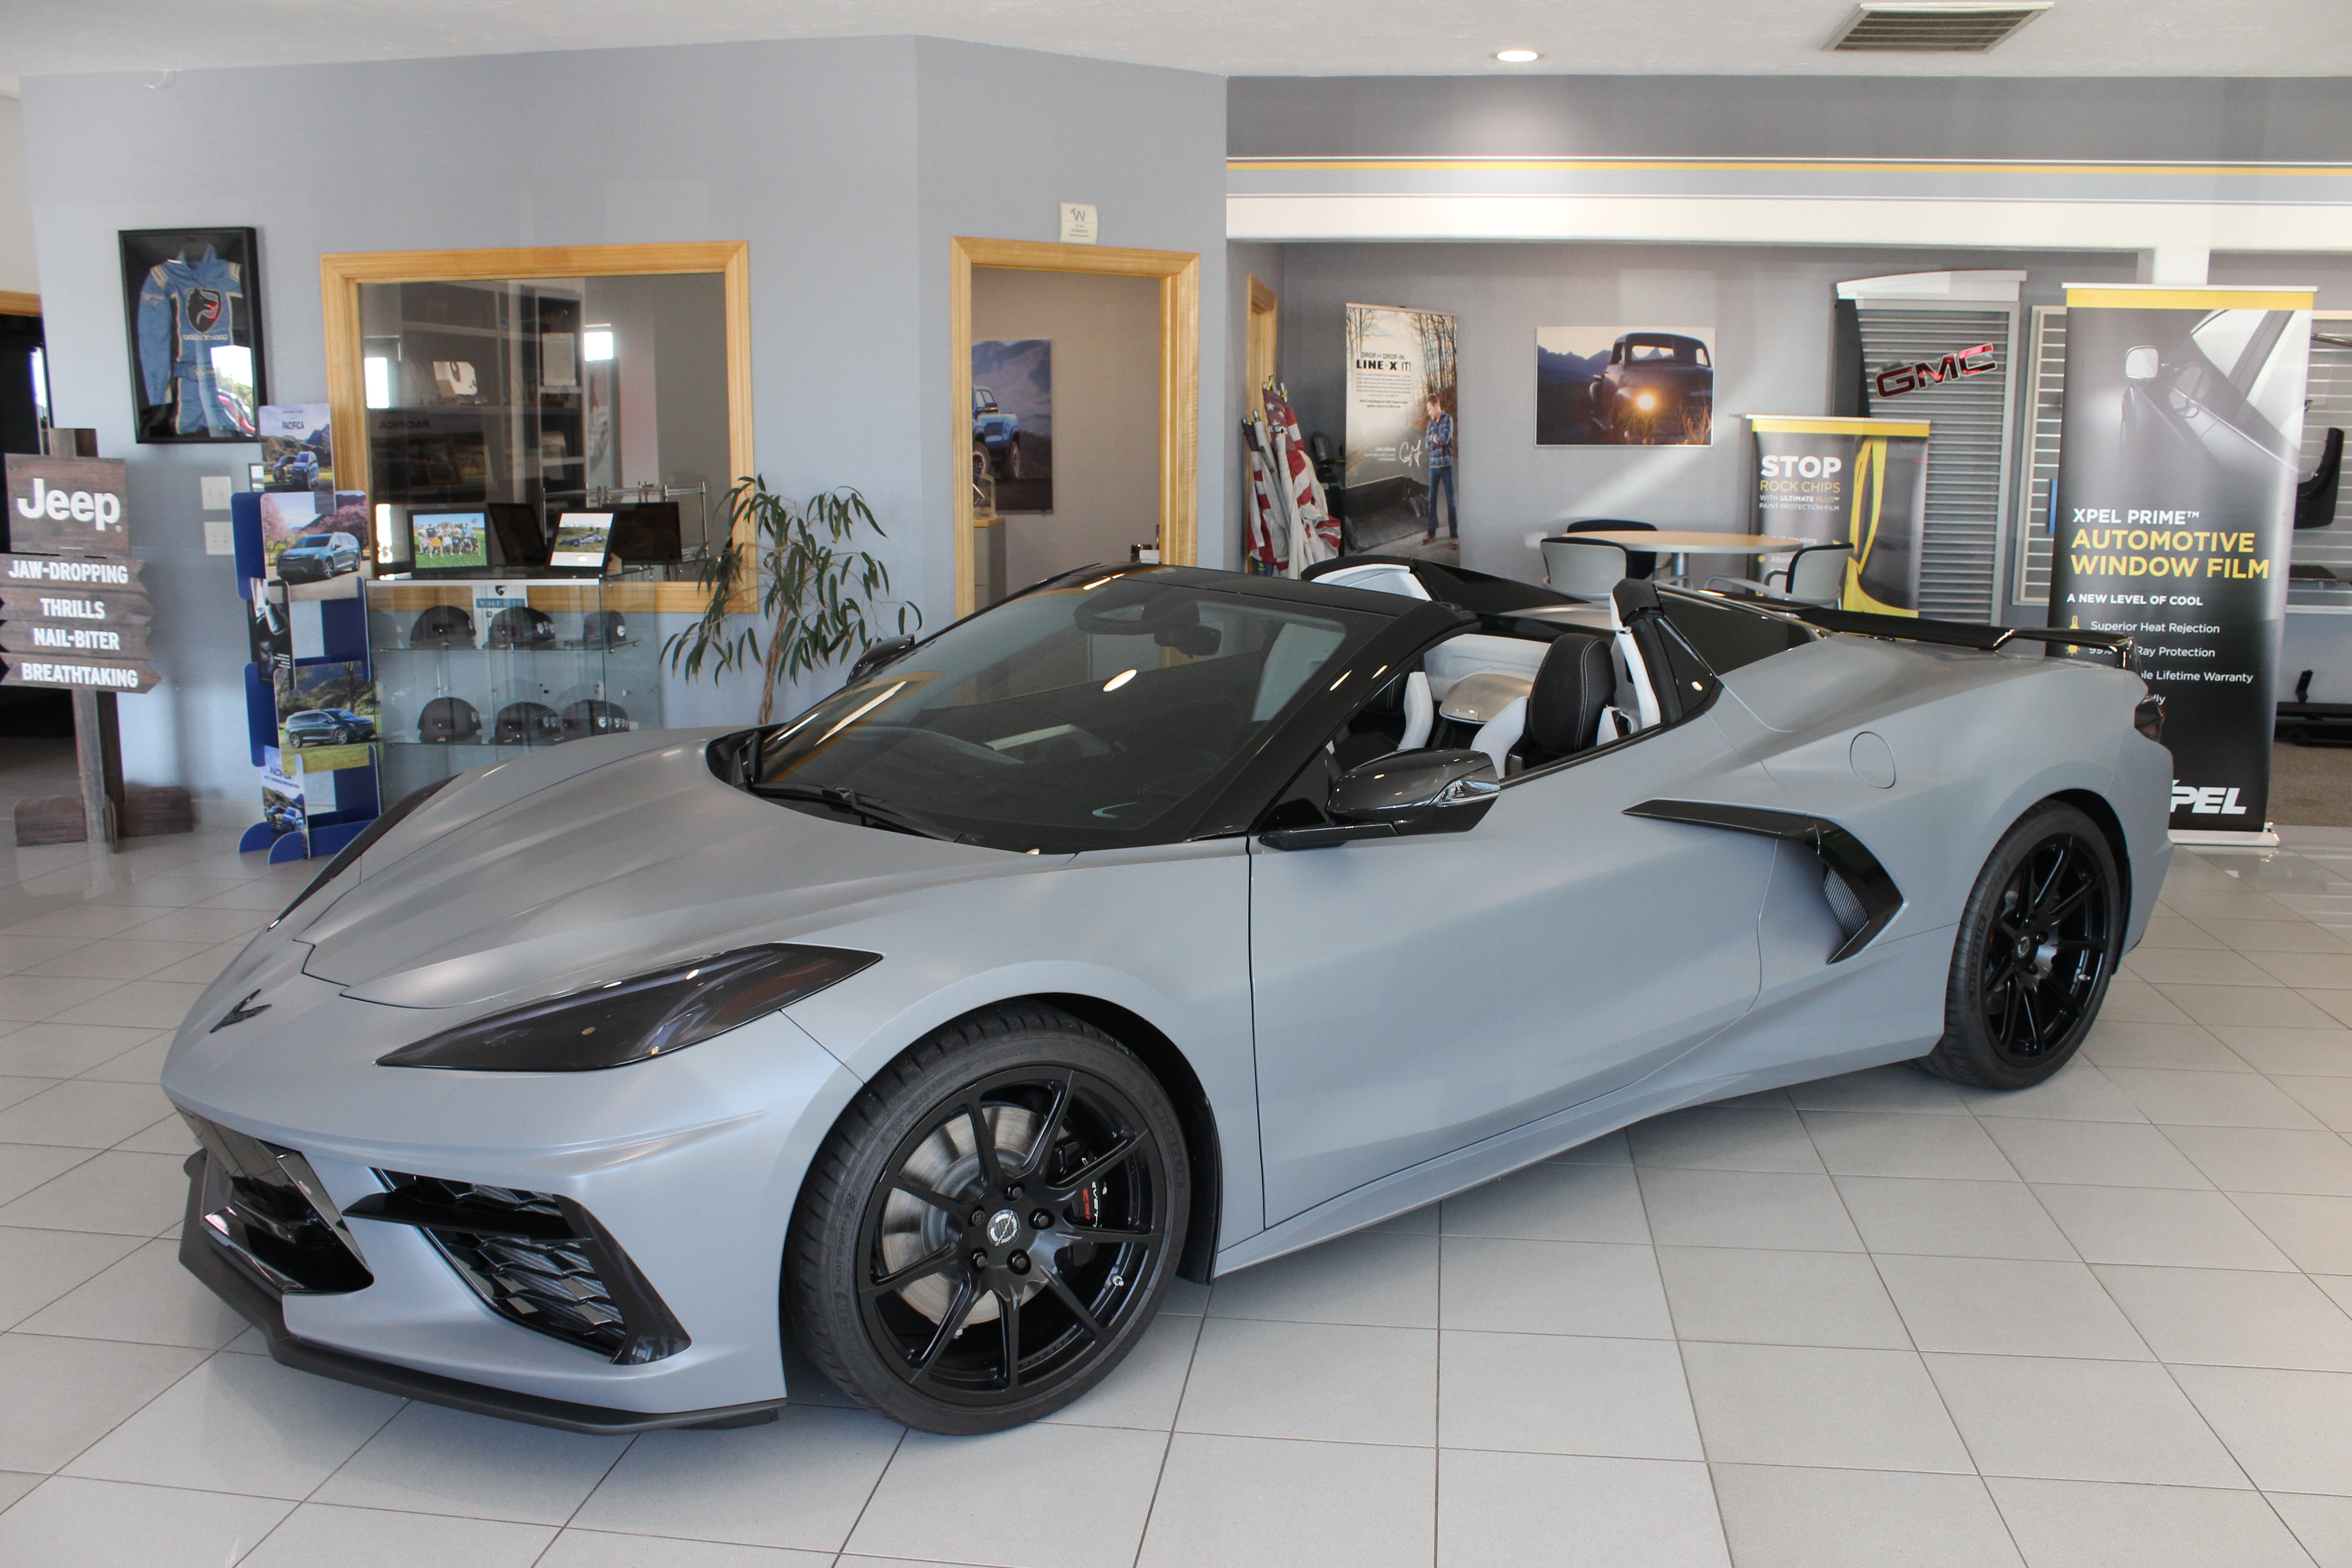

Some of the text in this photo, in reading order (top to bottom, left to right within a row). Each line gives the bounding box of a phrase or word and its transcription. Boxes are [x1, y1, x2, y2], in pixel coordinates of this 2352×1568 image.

[1401, 361, 1411, 371] IT!
[1877, 343, 1997, 397] GMC
[282, 421, 304, 429] PACIFICA
[1761, 455, 1842, 478] STOP
[1760, 480, 1841, 493] ROCK CHIPS
[17, 477, 121, 531] Jeep
[2072, 508, 2121, 524] XPEL
[2071, 529, 2255, 553] AUTOMOTIVE
[8, 560, 129, 584] JAW-DROPPING
[2071, 554, 2269, 579] WINDOW FILM
[40, 598, 106, 620] THRILLS
[2067, 593, 2203, 606] A NEW LEVEL OF COOL
[33, 627, 121, 650] NAIL-BITER
[2091, 621, 2220, 634] Superior Heat Rejection
[2159, 647, 2215, 657] Protection
[20, 662, 139, 688] BREATHTAKING
[2156, 670, 2200, 680] Lifetime
[2203, 671, 2254, 684] Warranty
[2170, 779, 2247, 814] PEL
